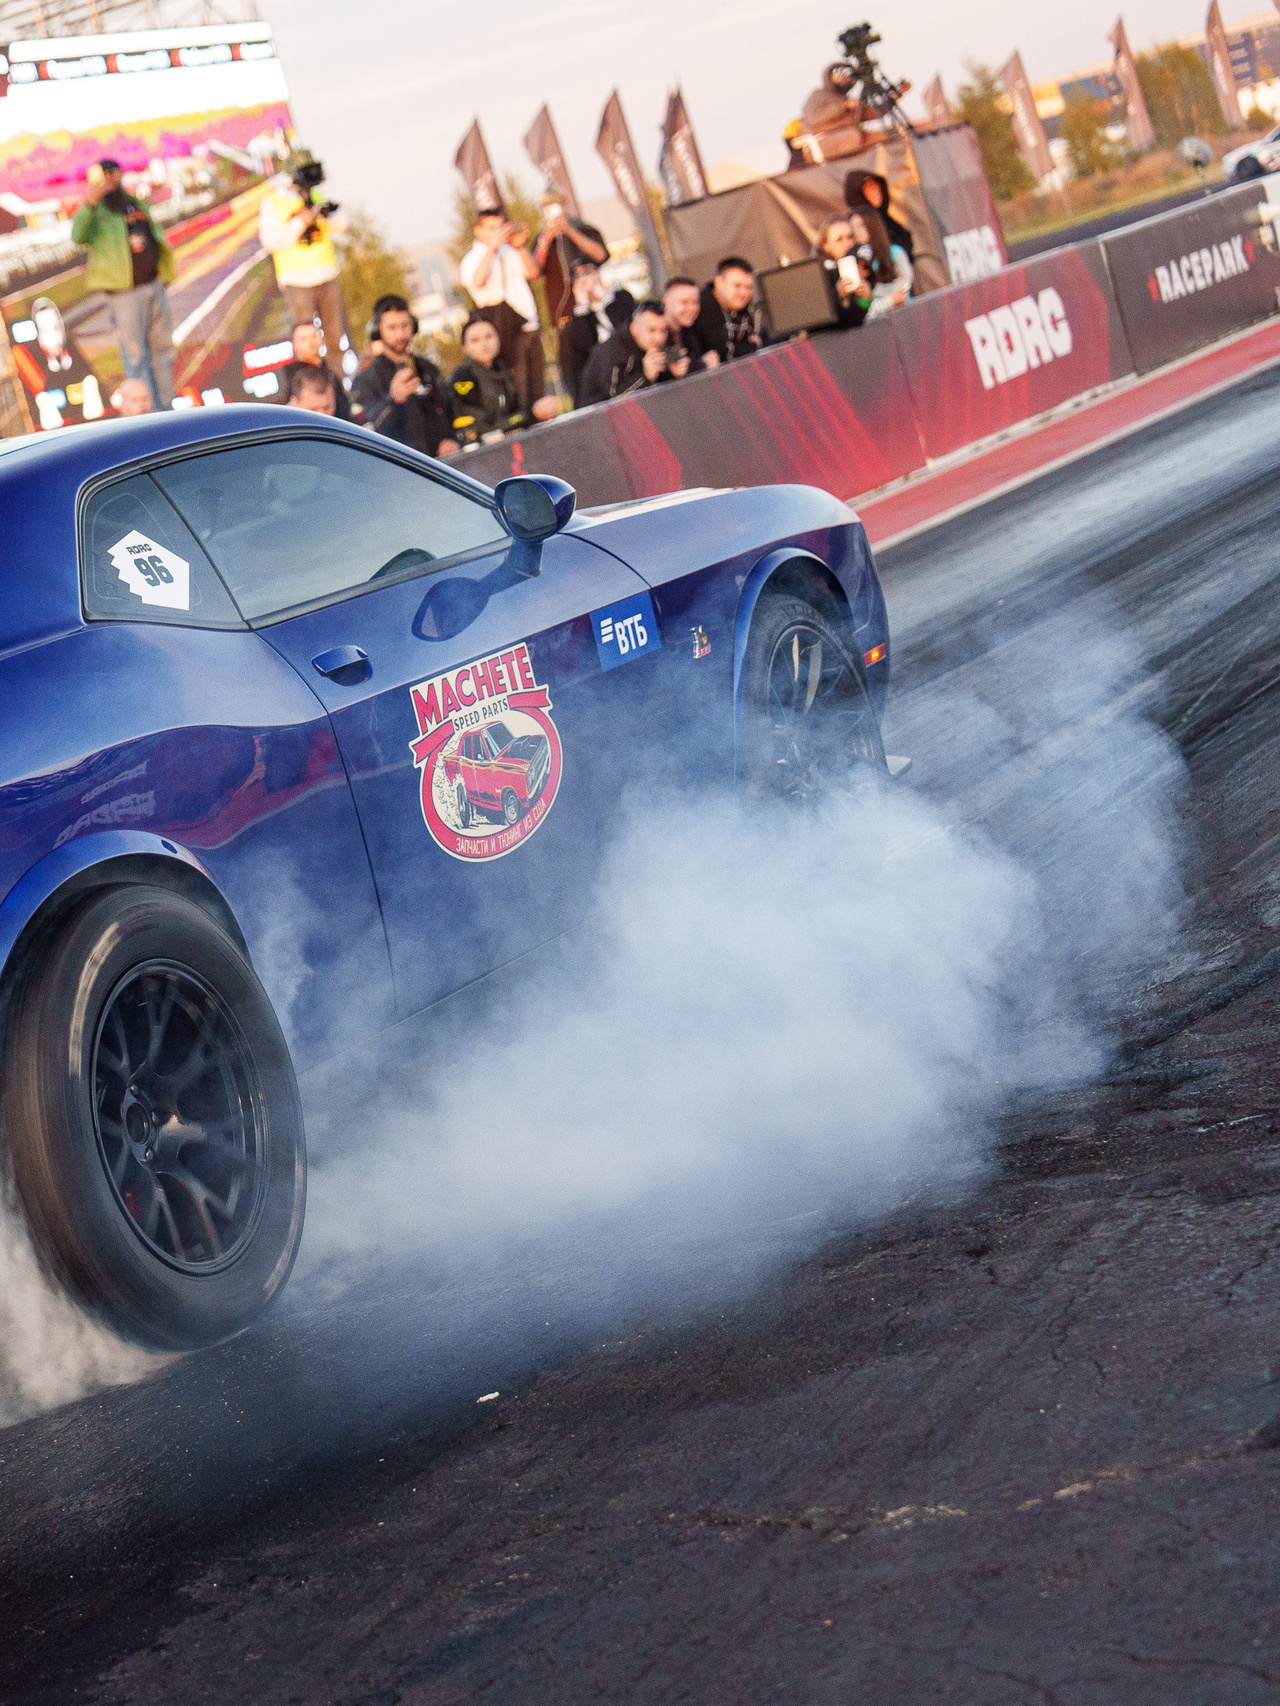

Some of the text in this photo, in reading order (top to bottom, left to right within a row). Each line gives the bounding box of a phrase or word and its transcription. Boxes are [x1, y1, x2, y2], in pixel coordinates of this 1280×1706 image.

[1155, 233, 1250, 303] RACEPARK
[965, 286, 1072, 390] RDRC
[126, 543, 152, 555] RDRC
[134, 555, 174, 587] 96
[614, 613, 648, 655] ВТБ
[412, 645, 535, 735] MACHETE
[453, 698, 509, 732] SPEED PARTS
[455, 798, 548, 854] ЗАПЧАСТИ И ТЮНИНГ ИЗ США
